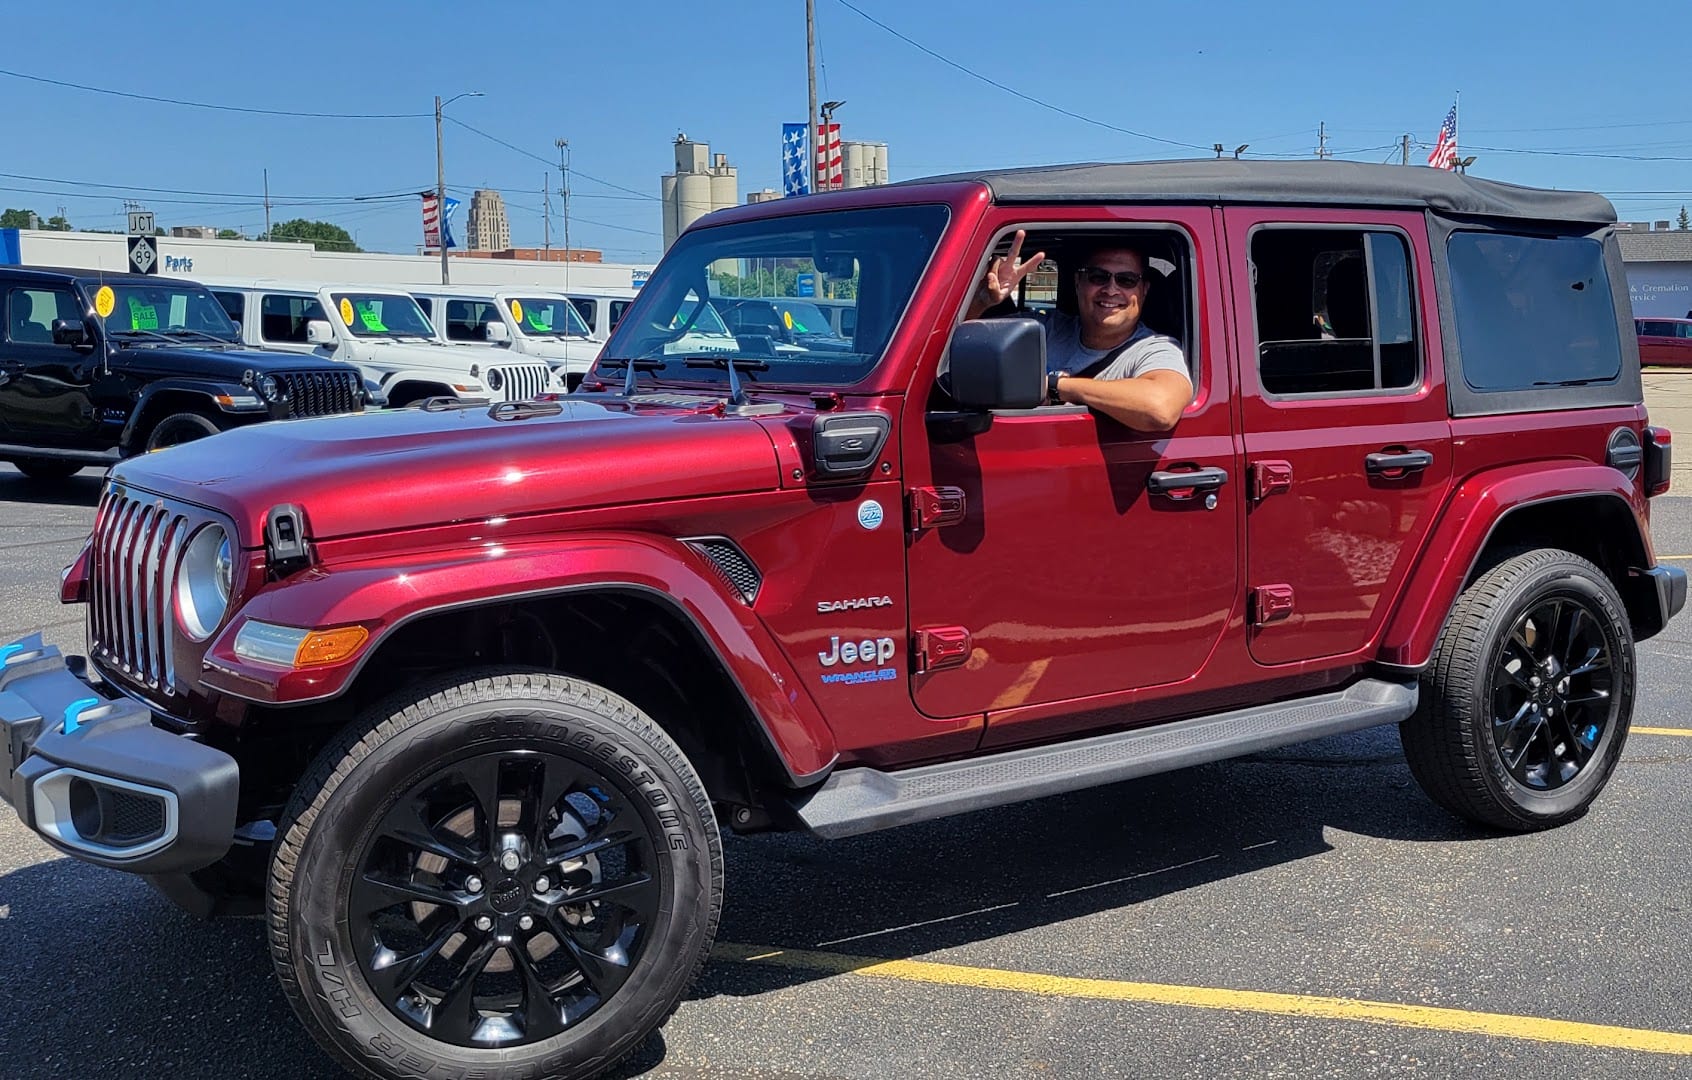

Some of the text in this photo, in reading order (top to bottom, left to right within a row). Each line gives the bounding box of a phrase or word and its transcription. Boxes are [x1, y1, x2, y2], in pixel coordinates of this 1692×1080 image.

[131, 216, 152, 231] JCT
[139, 241, 146, 250] M
[135, 251, 151, 265] 89
[165, 255, 193, 268] Parts
[1630, 283, 1689, 293] & Cremation
[1630, 293, 1657, 301] ervice
[133, 311, 156, 321] SALE
[817, 595, 893, 613] SAHARA
[819, 636, 896, 666] Jeep
[821, 668, 897, 684] WRANGLER
[471, 717, 689, 852] BRIDGESTONE
